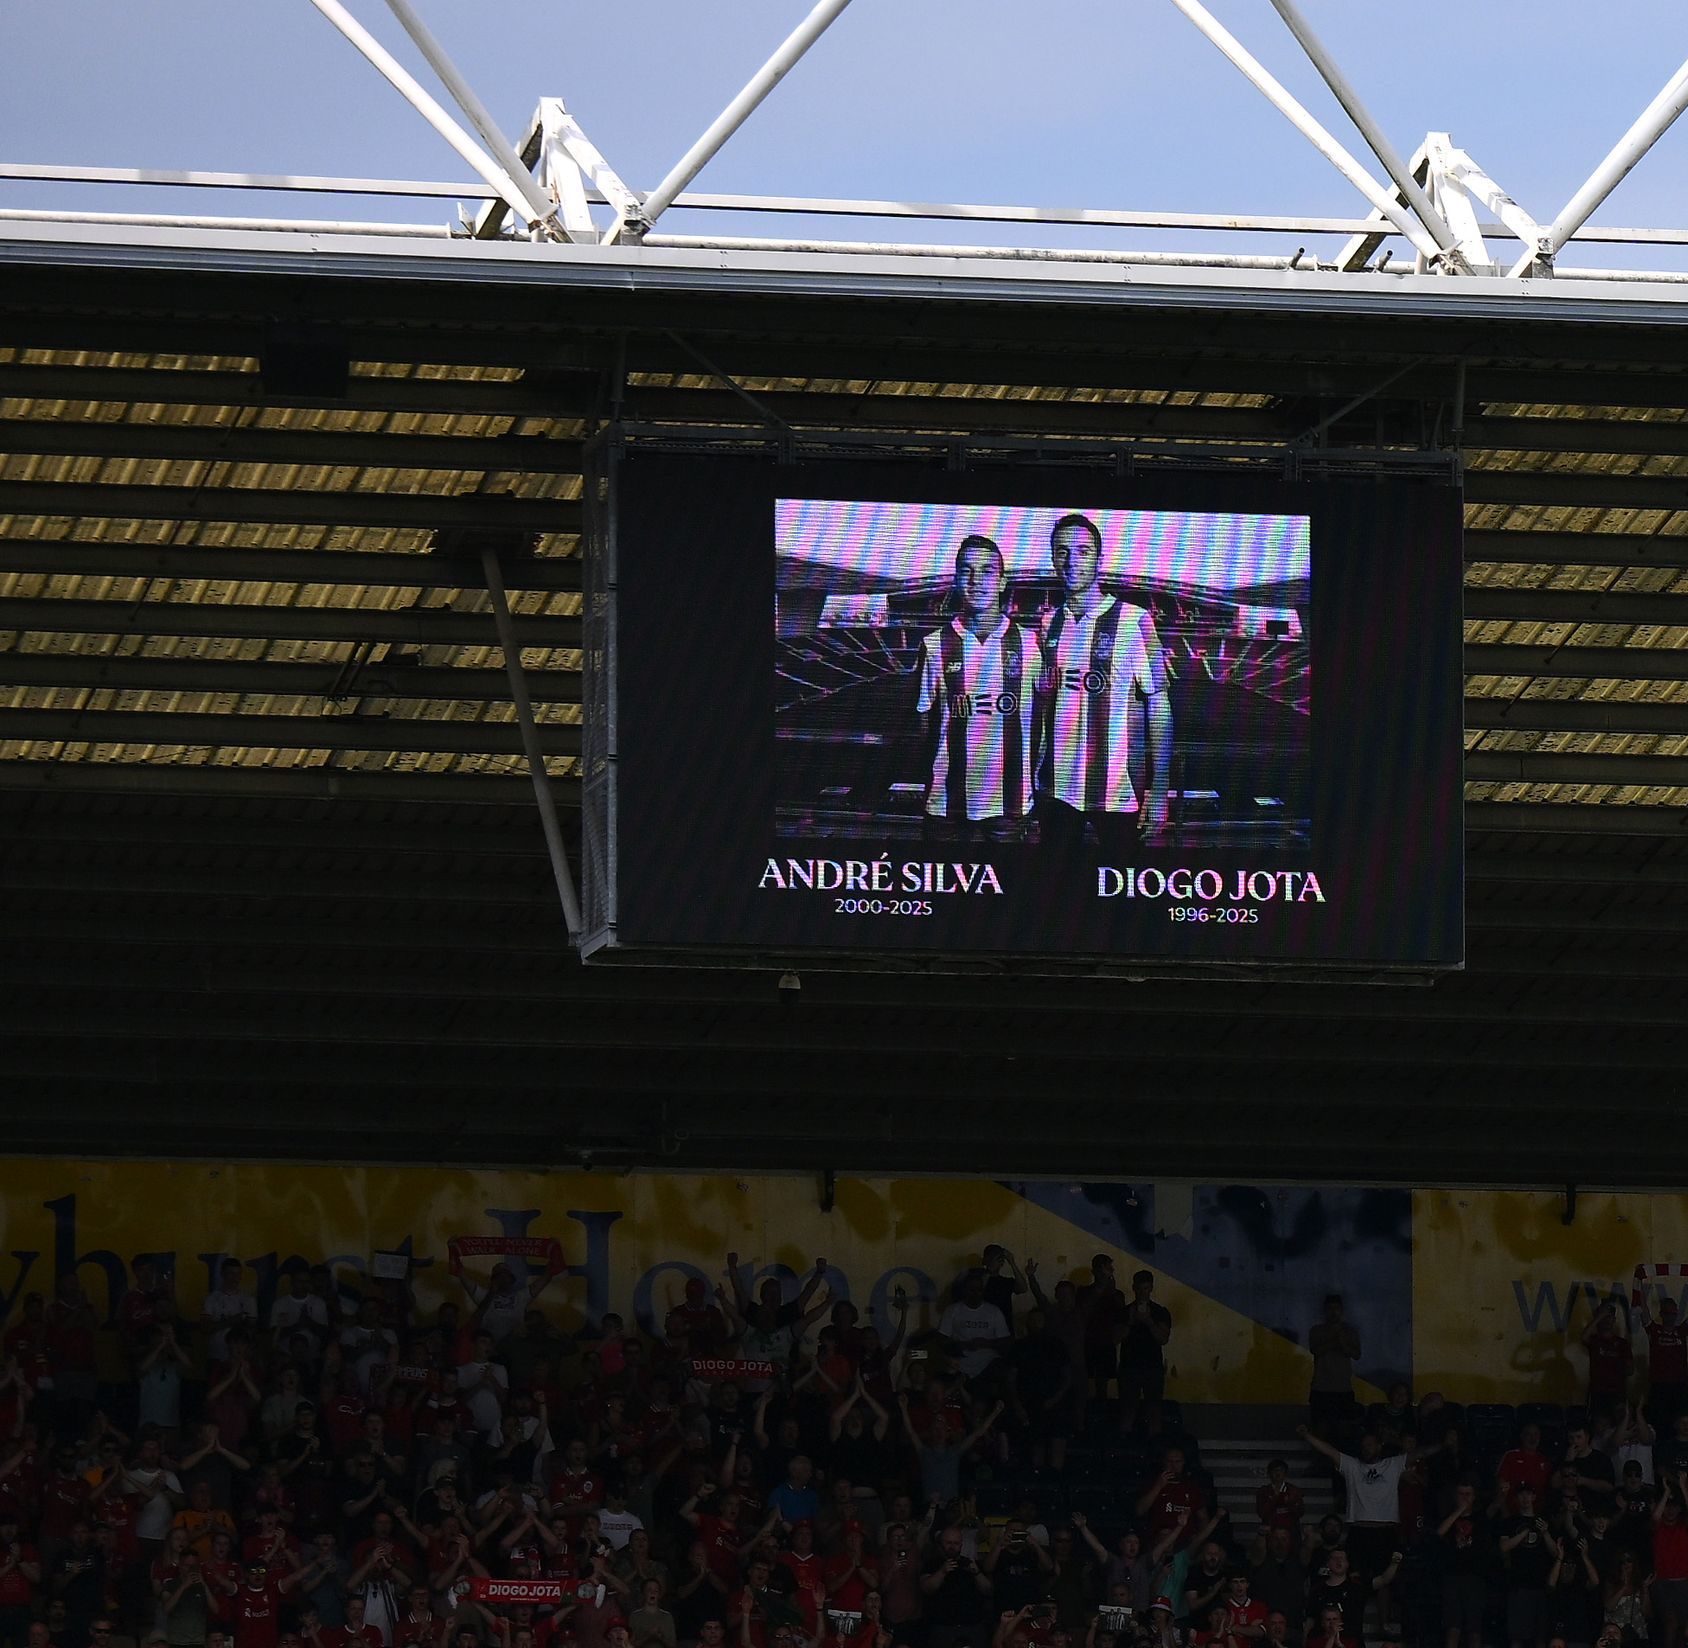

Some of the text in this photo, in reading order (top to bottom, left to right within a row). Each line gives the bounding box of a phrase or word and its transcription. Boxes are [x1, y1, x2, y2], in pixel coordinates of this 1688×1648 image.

[758, 852, 1004, 896] ANDRÉ SILVA
[1096, 857, 1326, 904] DIOGO JOTA
[834, 905, 933, 923] 2000-2025
[1168, 905, 1260, 922] 1996-2025
[693, 1360, 773, 1373] DIOGO JOTA
[489, 1584, 561, 1597] DIOGO JOTA
